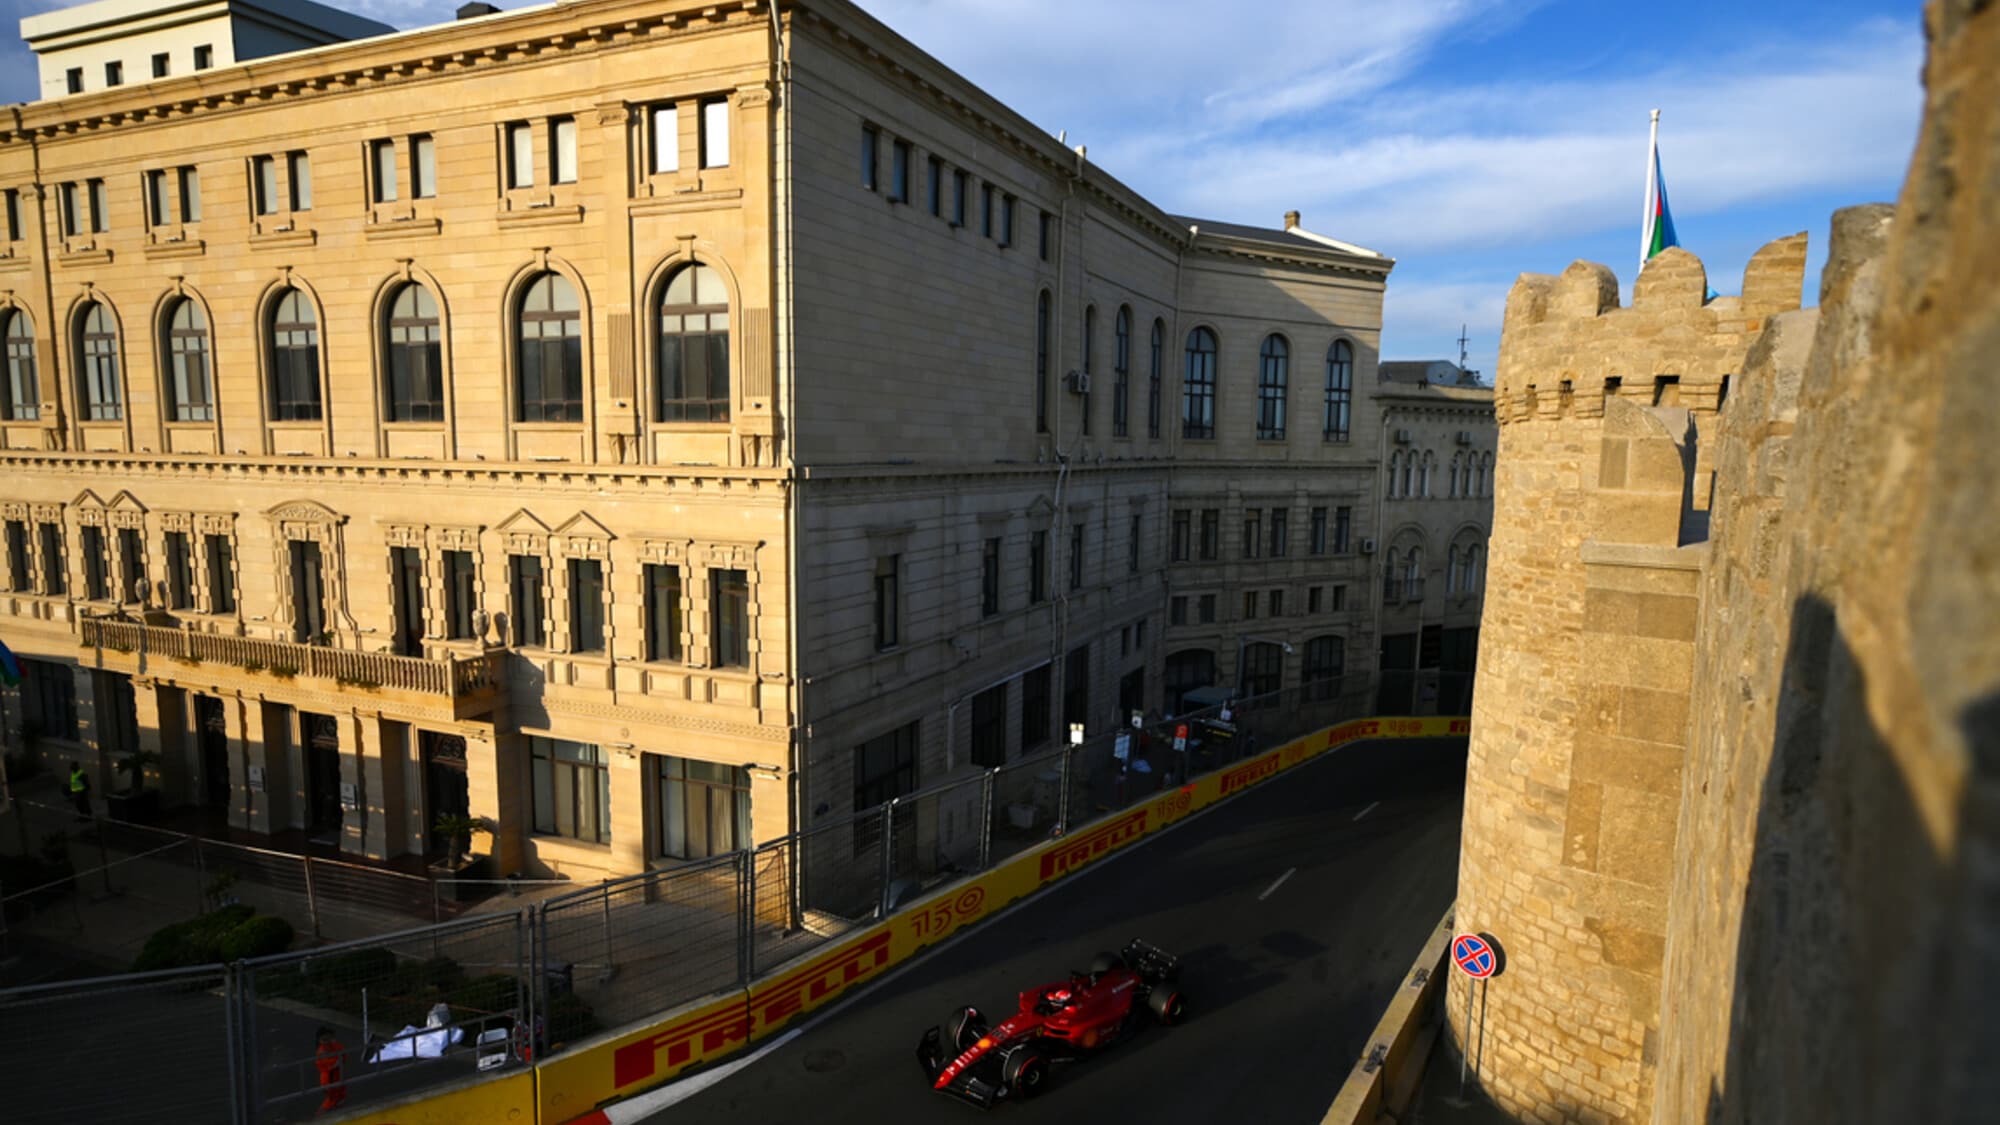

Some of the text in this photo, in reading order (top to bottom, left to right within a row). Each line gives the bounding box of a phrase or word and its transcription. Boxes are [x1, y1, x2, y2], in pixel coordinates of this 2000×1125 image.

[1040, 809, 1148, 880] PIRELLI
[911, 886, 985, 938] 150
[614, 930, 891, 1089] PIRELLI
